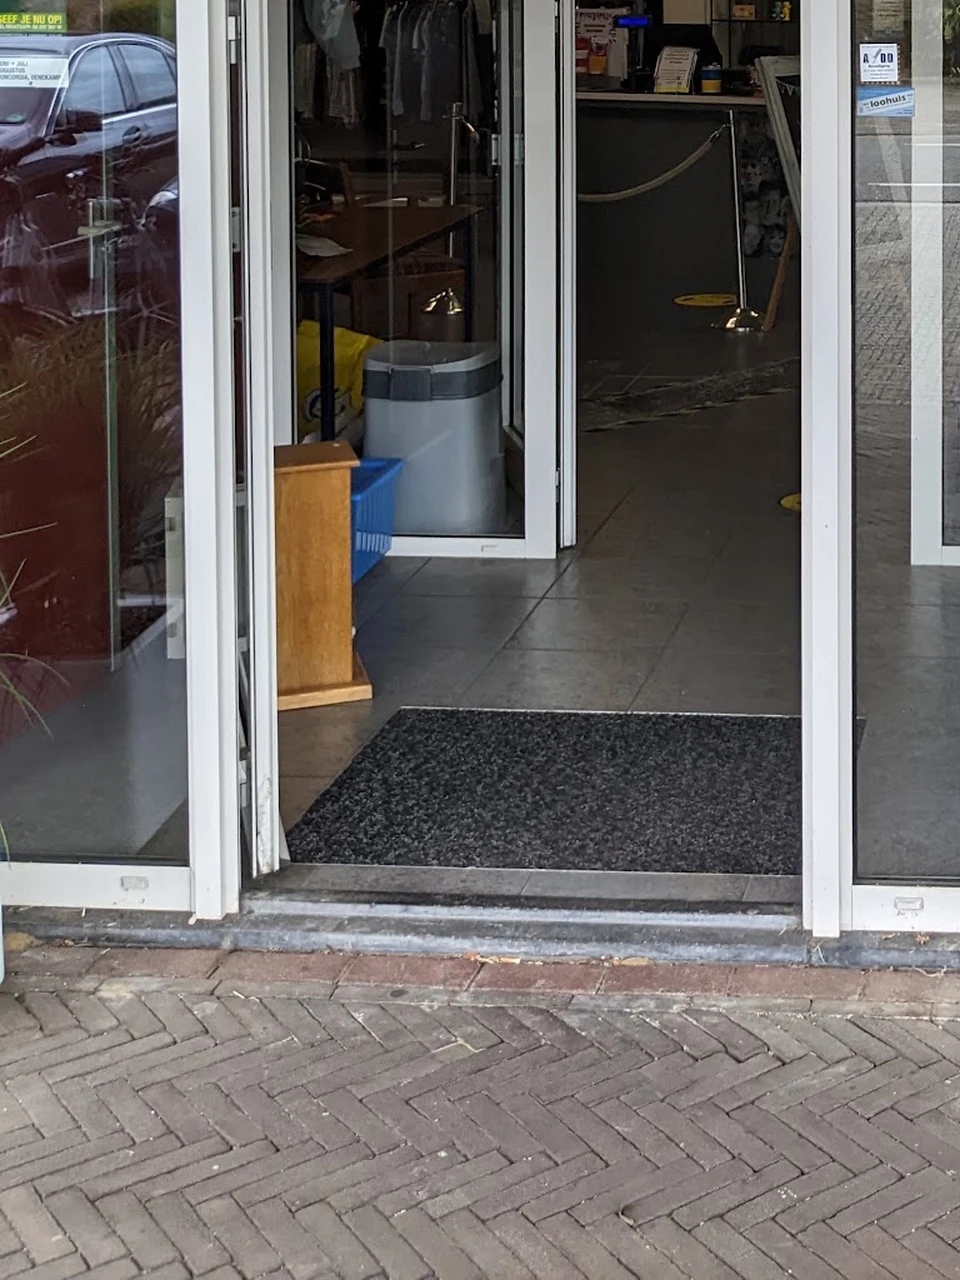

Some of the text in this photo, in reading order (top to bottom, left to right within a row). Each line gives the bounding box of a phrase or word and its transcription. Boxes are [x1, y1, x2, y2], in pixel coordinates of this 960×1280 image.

[20, 14, 31, 24] JE
[33, 14, 45, 24] NU
[47, 14, 62, 24] OP!
[870, 94, 907, 108] loohuis
